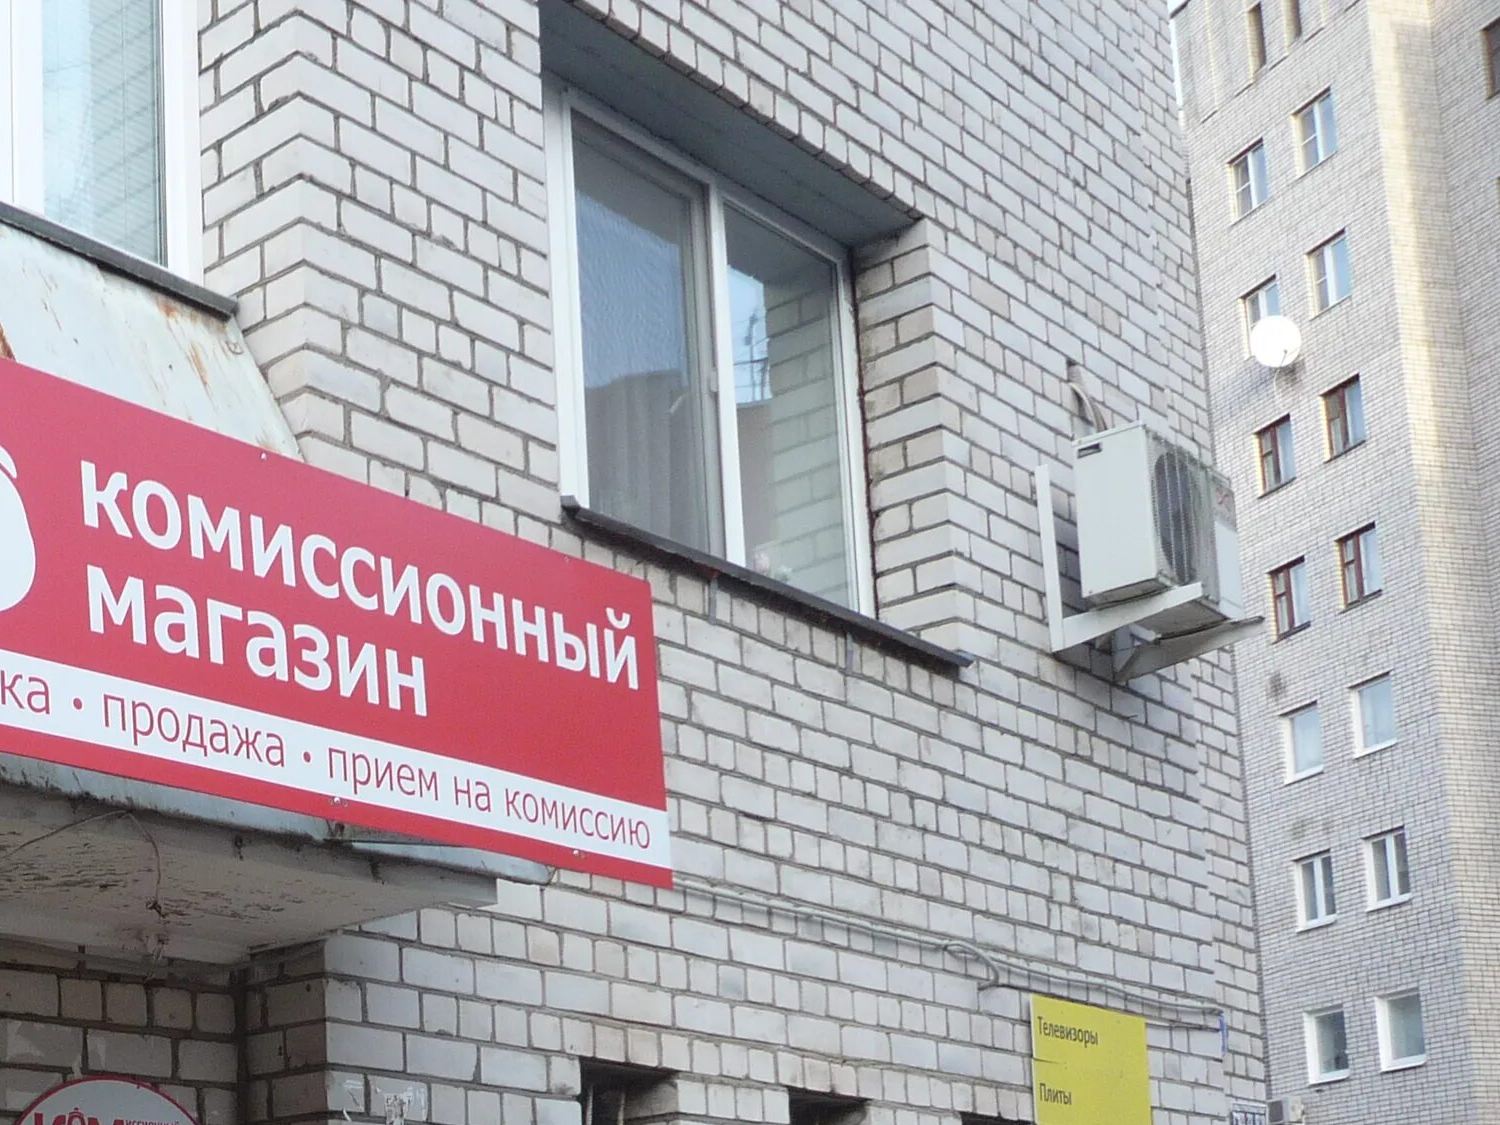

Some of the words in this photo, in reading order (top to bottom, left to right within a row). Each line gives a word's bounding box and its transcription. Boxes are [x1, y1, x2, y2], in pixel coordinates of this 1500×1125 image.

[80, 460, 639, 690] комиссионный
[87, 564, 427, 717] магазин
[102, 693, 286, 767] продажа
[328, 747, 439, 801] прием
[453, 775, 492, 813] на
[504, 788, 650, 849] комиссию
[1037, 1016, 1098, 1048] Телевизоры
[1039, 1082, 1072, 1105] Плиты
